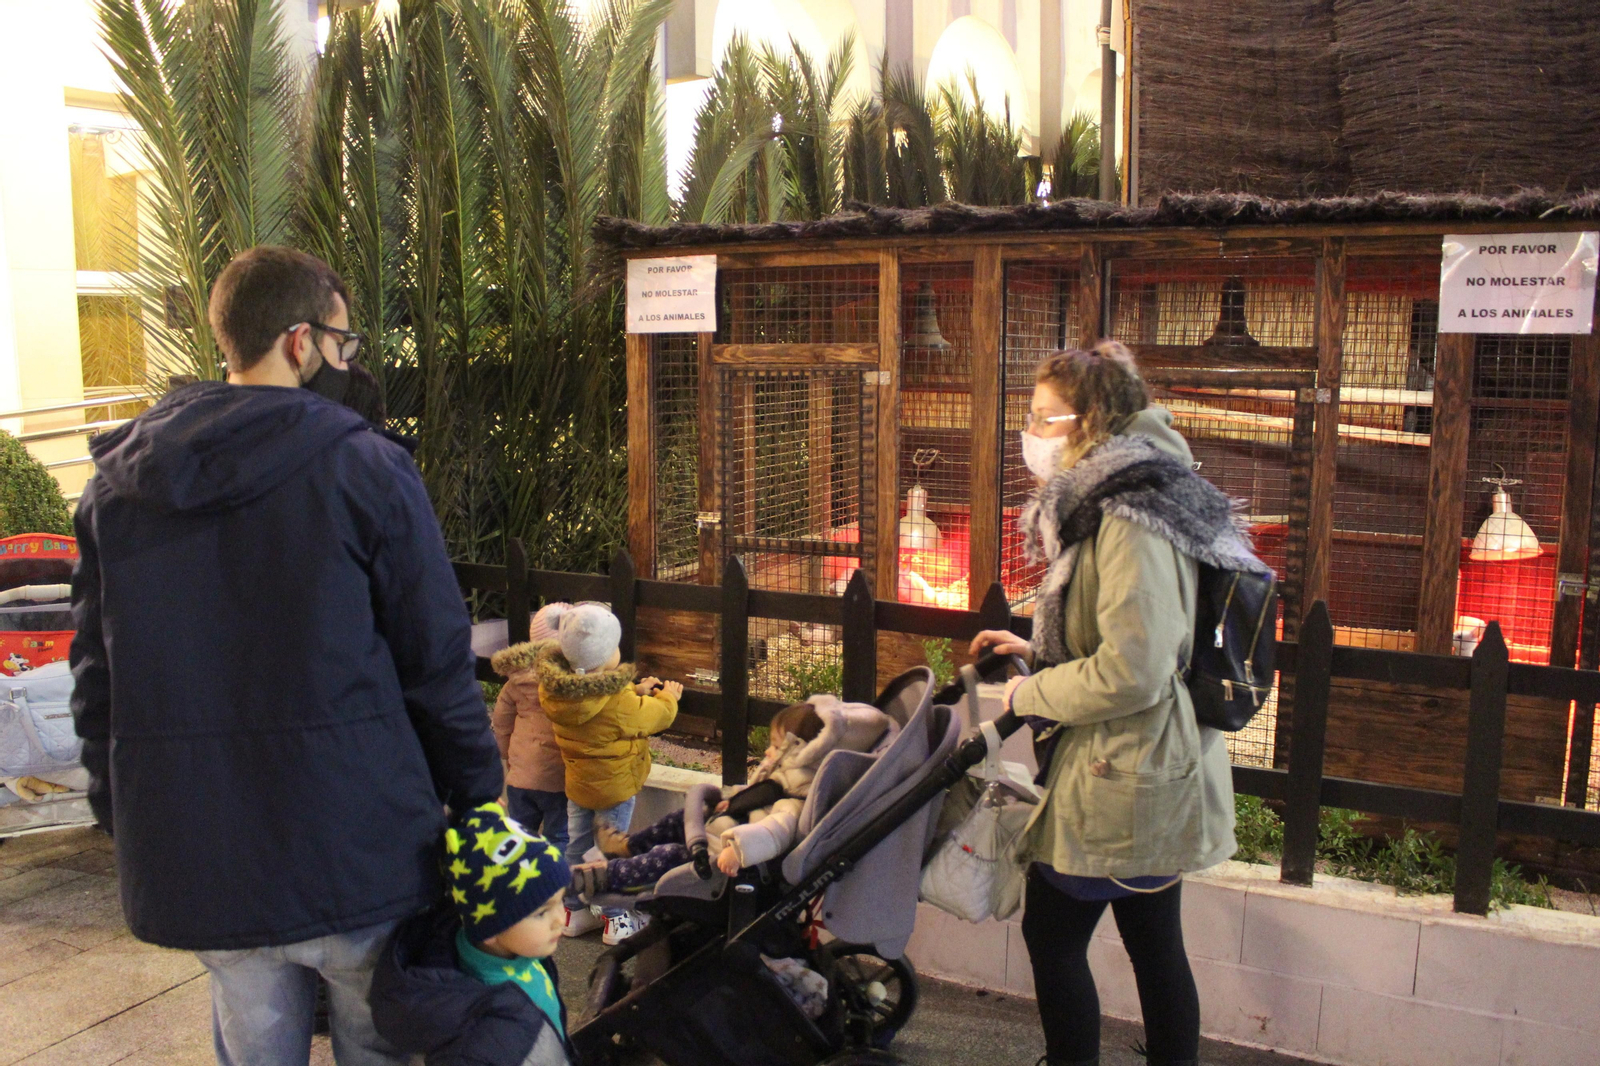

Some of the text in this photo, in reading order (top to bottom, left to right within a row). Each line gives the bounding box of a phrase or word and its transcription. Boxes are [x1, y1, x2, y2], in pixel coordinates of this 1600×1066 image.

[1479, 244, 1557, 255] POR FAVOR
[1466, 276, 1566, 286] NO MOLESTAR
[655, 289, 698, 297] MOLESTAR
[1457, 308, 1574, 318] A LOS ANIMALES
[43, 539, 77, 554] Baby
